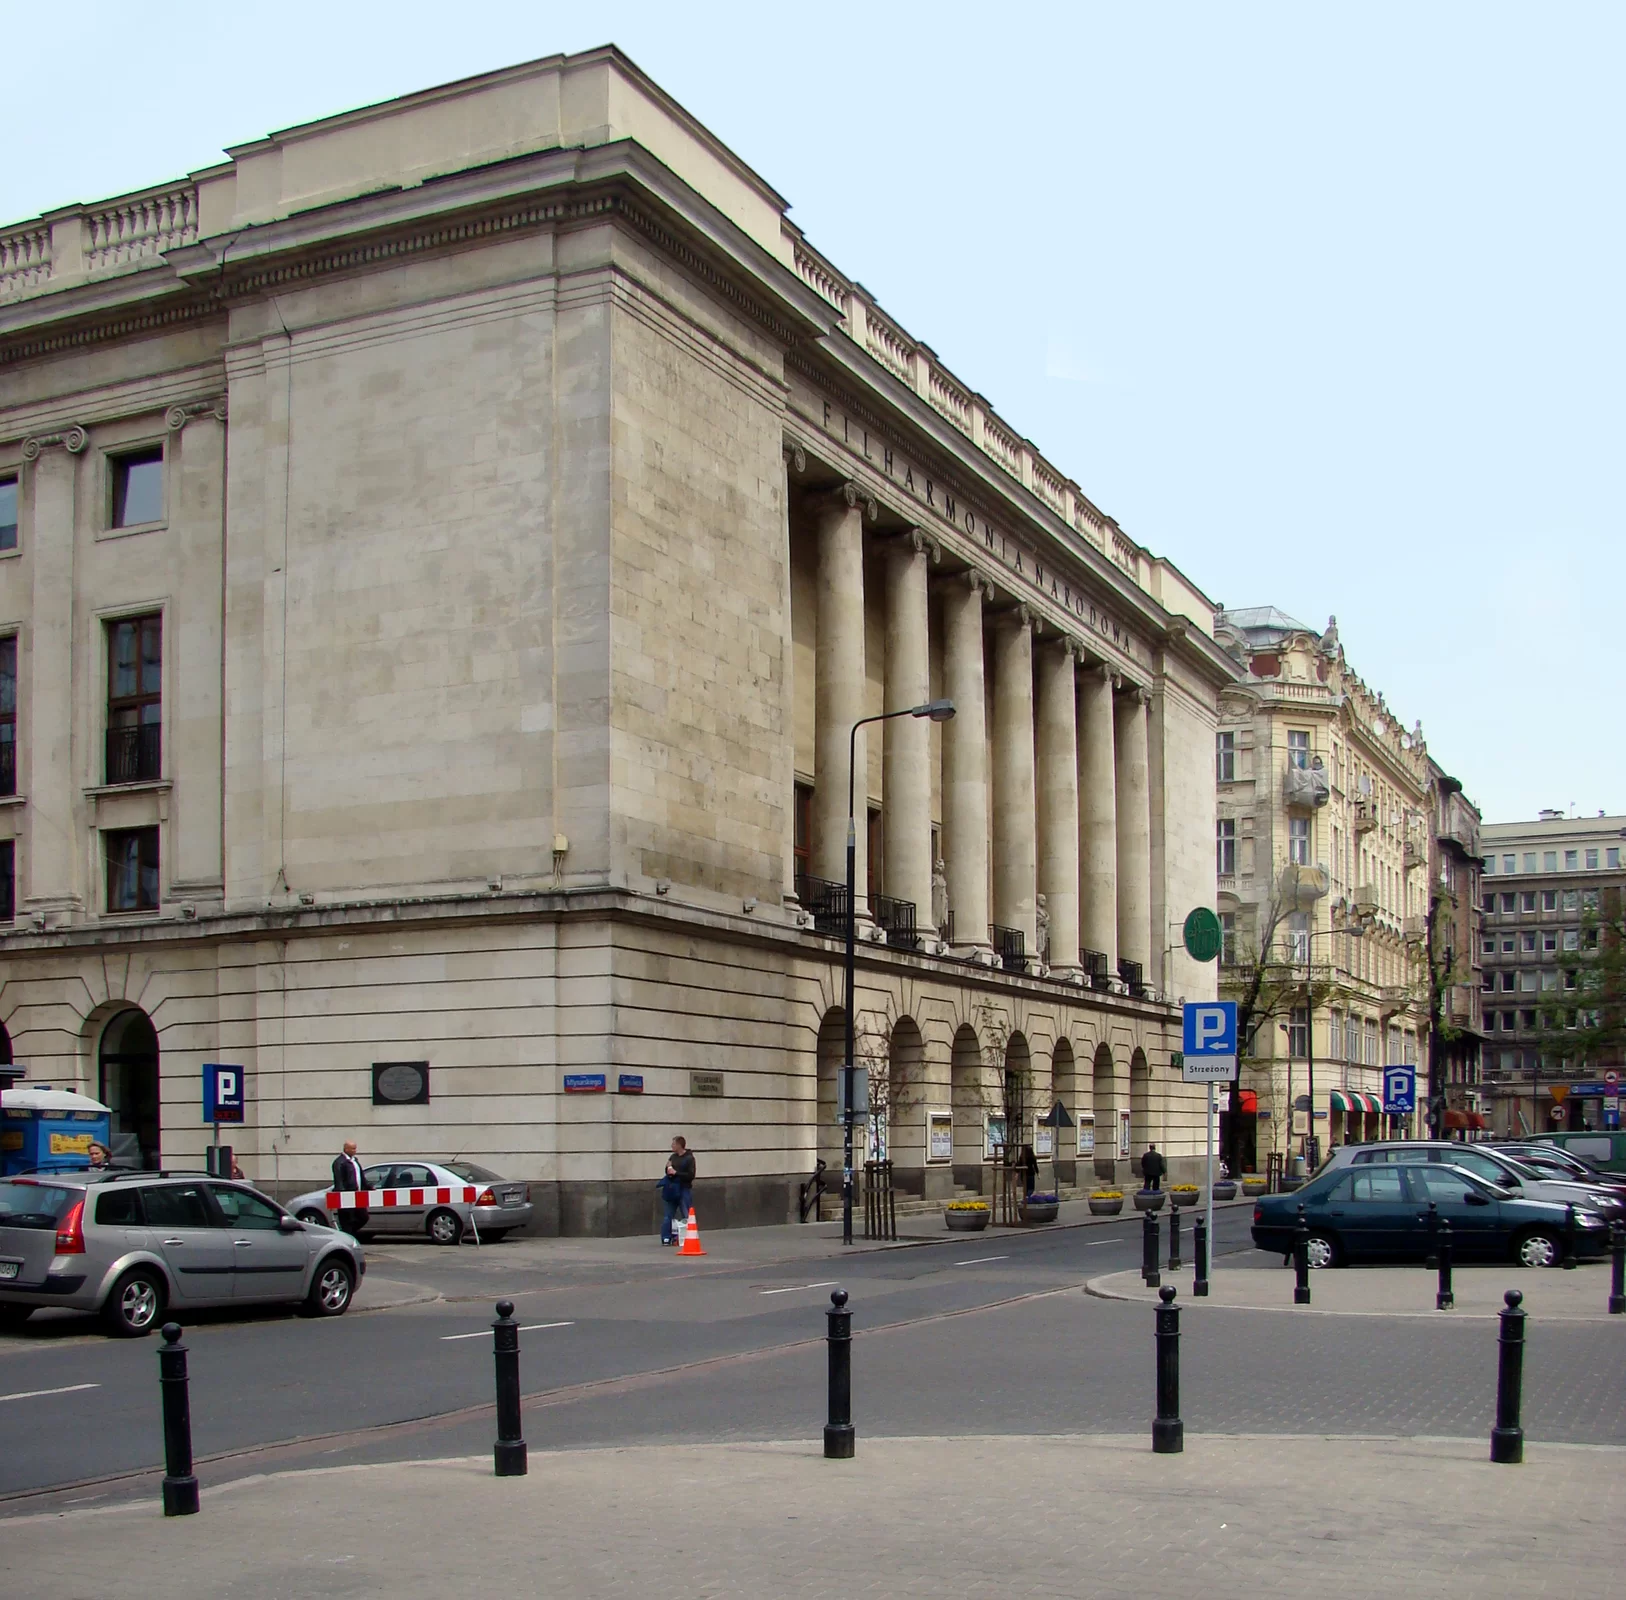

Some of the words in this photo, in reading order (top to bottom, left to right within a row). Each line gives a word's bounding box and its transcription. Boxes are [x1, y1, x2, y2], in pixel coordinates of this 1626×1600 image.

[823, 401, 1023, 573] FILHARMONIA
[1036, 563, 1131, 653] NARODOWA
[1195, 1008, 1226, 1049] P
[1189, 1064, 1230, 1075] Strzeżony
[218, 1071, 236, 1105] P
[1389, 1076, 1408, 1101] P
